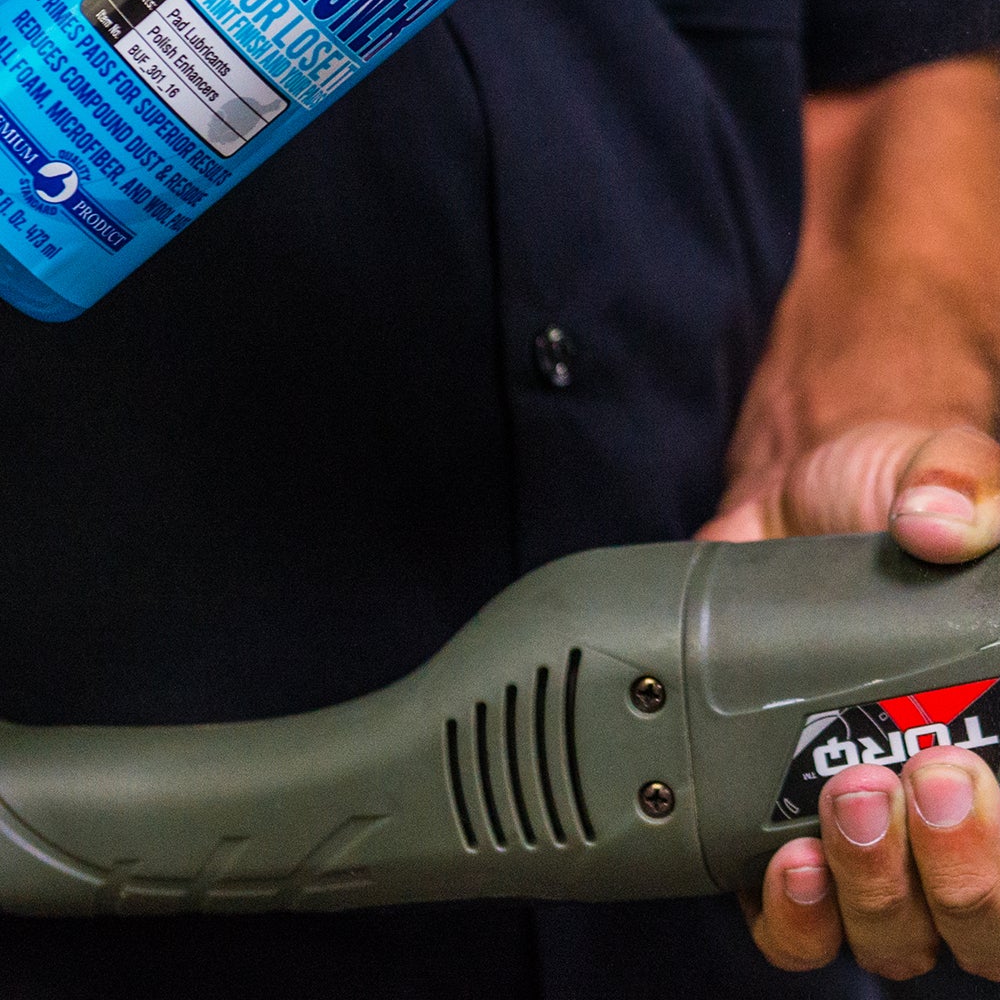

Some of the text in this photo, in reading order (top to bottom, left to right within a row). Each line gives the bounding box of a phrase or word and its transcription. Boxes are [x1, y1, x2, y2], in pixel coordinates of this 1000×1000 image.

[96, 9, 113, 28] Item
[166, 8, 231, 77] Pad Lubricants
[227, 15, 273, 60] FINISH
[259, 49, 291, 78] AND
[271, 14, 345, 82] LOSE
[127, 43, 180, 98] BUF_301_16
[147, 25, 220, 102] Polish Enhancers
[12, 9, 68, 73] REDUCES
[59, 66, 134, 143] COMPOUND
[124, 135, 165, 172] DUST
[155, 164, 173, 181] &
[75, 34, 117, 78] PADS
[107, 70, 141, 105] FOR
[133, 97, 197, 159] SUPERIOR
[186, 149, 232, 187] RESULTS
[9, 58, 53, 109] FOAM,
[45, 100, 126, 187] MICROFIBER,
[119, 177, 152, 205] AND
[58, 149, 91, 181] QUALITY
[19, 178, 58, 216] STANDARD
[72, 200, 127, 246] PRODUCT
[25, 224, 50, 248] 473
[41, 244, 63, 260] ml
[812, 716, 999, 777] TORQ
